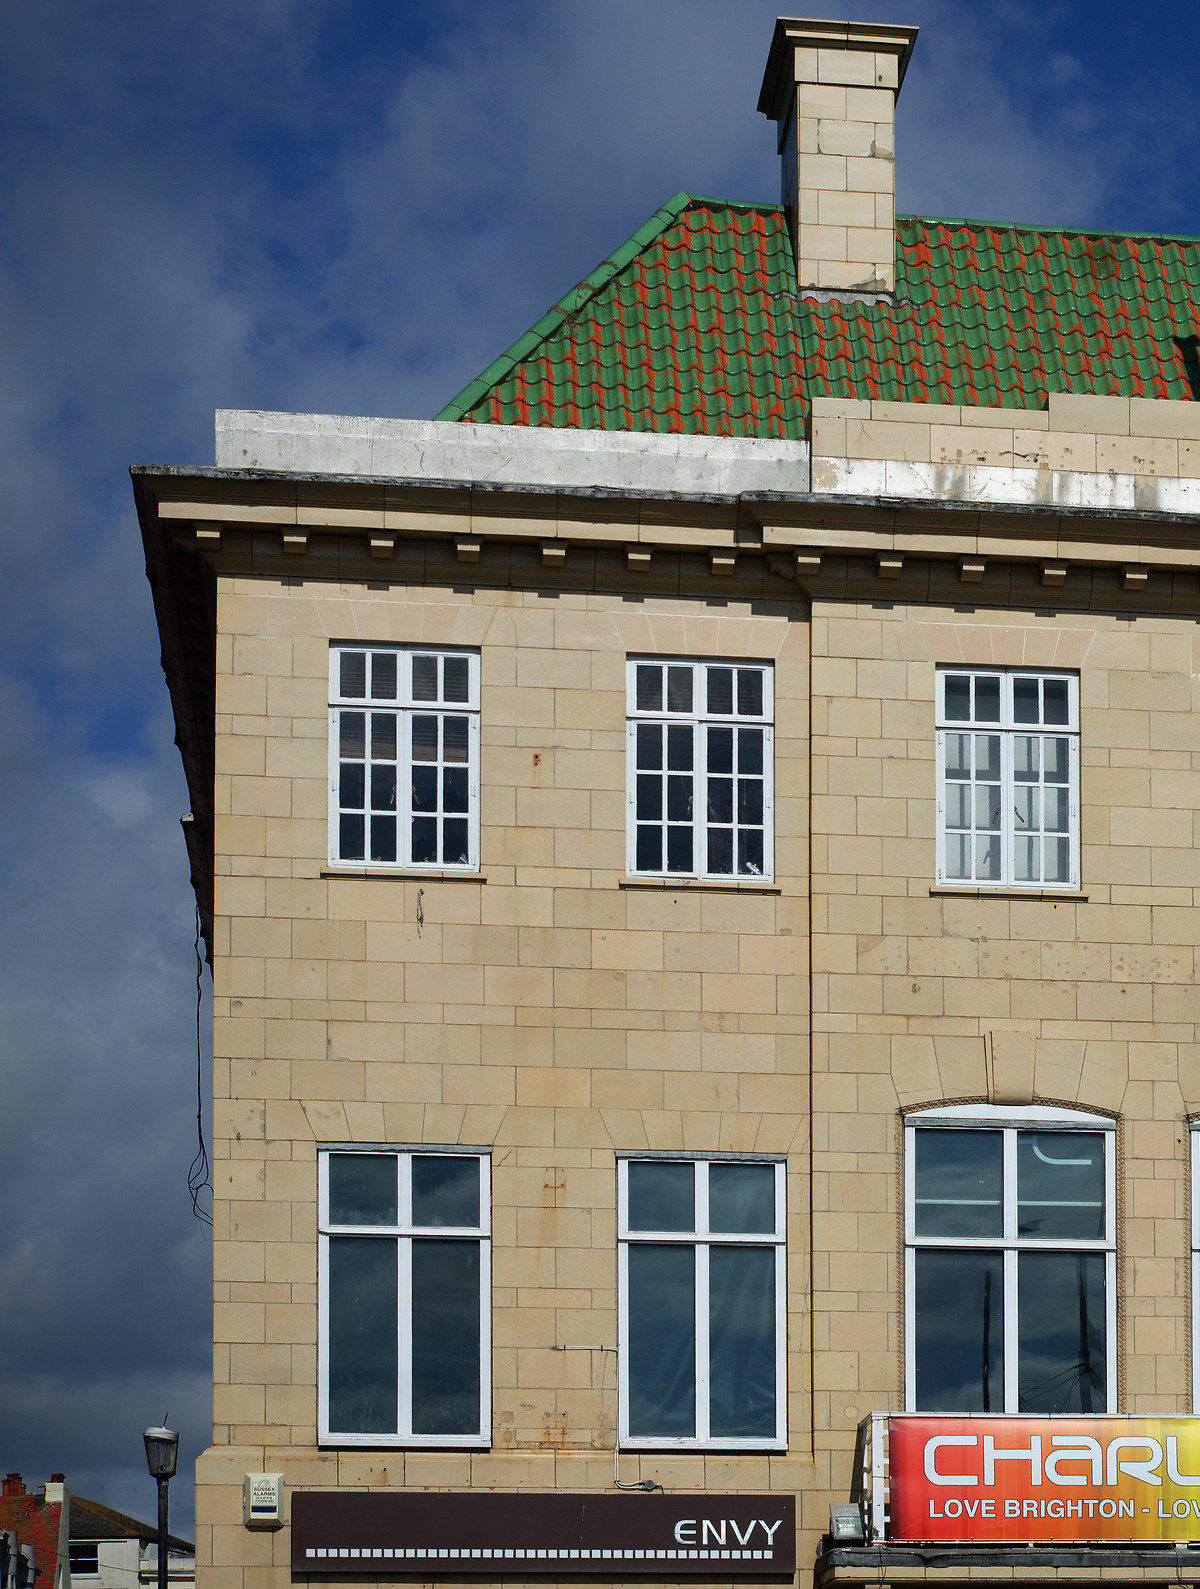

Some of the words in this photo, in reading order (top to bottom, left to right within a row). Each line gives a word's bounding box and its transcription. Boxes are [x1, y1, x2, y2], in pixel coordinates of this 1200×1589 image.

[929, 1498, 996, 1519] LOVE
[1004, 1498, 1135, 1519] BRIGHTON
[674, 1519, 783, 1546] ENVY
